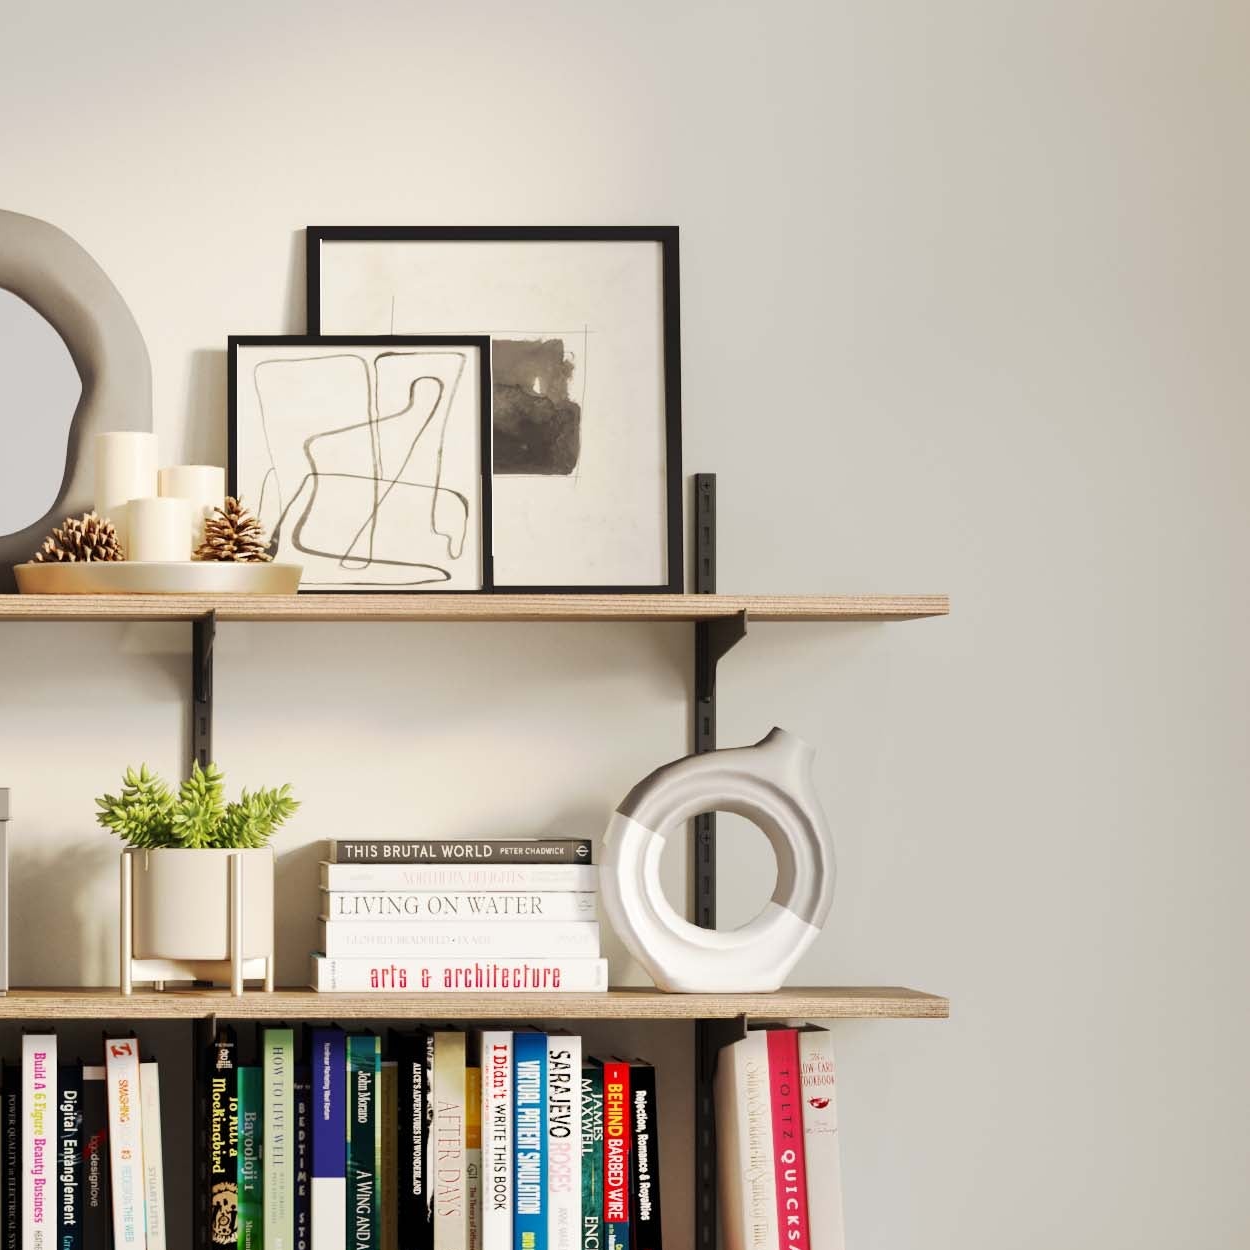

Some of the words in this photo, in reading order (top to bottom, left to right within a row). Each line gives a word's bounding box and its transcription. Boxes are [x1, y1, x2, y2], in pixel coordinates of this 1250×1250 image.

[345, 845, 378, 857] THIS
[384, 845, 437, 857] BRUTAL
[442, 845, 493, 857] WORLD
[500, 847, 524, 855] PETER
[525, 847, 564, 855] CHADWICK
[338, 896, 419, 914] LIVING
[427, 896, 459, 914] ON
[467, 896, 543, 914] WATER
[370, 964, 406, 988] arts
[444, 963, 561, 989] architecture
[34, 1053, 46, 1079] Build
[272, 1047, 284, 1076] HOW
[358, 1070, 371, 1090] John
[493, 1055, 507, 1099] Didn't
[34, 1082, 46, 1090] A
[272, 1082, 284, 1097] TO
[518, 1060, 540, 1106] VIRTUAL
[549, 1050, 571, 1138] SARAJEVO
[31, 1102, 46, 1135] Figure
[61, 1090, 77, 1132] Digital
[272, 1103, 284, 1130] LIVE
[358, 1092, 371, 1123] Morano
[493, 1103, 506, 1141] WRITE
[581, 1078, 593, 1157] MAXWELL
[592, 1093, 603, 1141] JAMES
[608, 1083, 623, 1136] BEHIND
[633, 1090, 647, 1133] Rejection,
[779, 1068, 793, 1140] TOLTZ
[212, 1078, 226, 1173] Mockingbird
[438, 1102, 461, 1160] AFTER
[518, 1108, 540, 1150] PATIENT
[31, 1139, 46, 1174] Beauty
[242, 1112, 256, 1180] Bayooloji
[272, 1135, 284, 1167] WELL
[297, 1102, 306, 1196] BEDTIME
[493, 1146, 506, 1172] THIS
[608, 1139, 623, 1187] BARBED
[636, 1134, 649, 1172] Romance
[61, 1139, 77, 1225] Entanglement
[356, 1170, 370, 1178] A
[518, 1152, 540, 1214] SIMULATION
[549, 1143, 571, 1193] ROSES
[34, 1179, 46, 1223] Business
[356, 1181, 372, 1211] WING
[436, 1169, 461, 1217] DAYS
[493, 1176, 507, 1210] BOOK
[607, 1189, 623, 1219] WIRE
[638, 1182, 652, 1220] Royalties
[356, 1213, 370, 1240] AND
[357, 1242, 370, 1250] A
